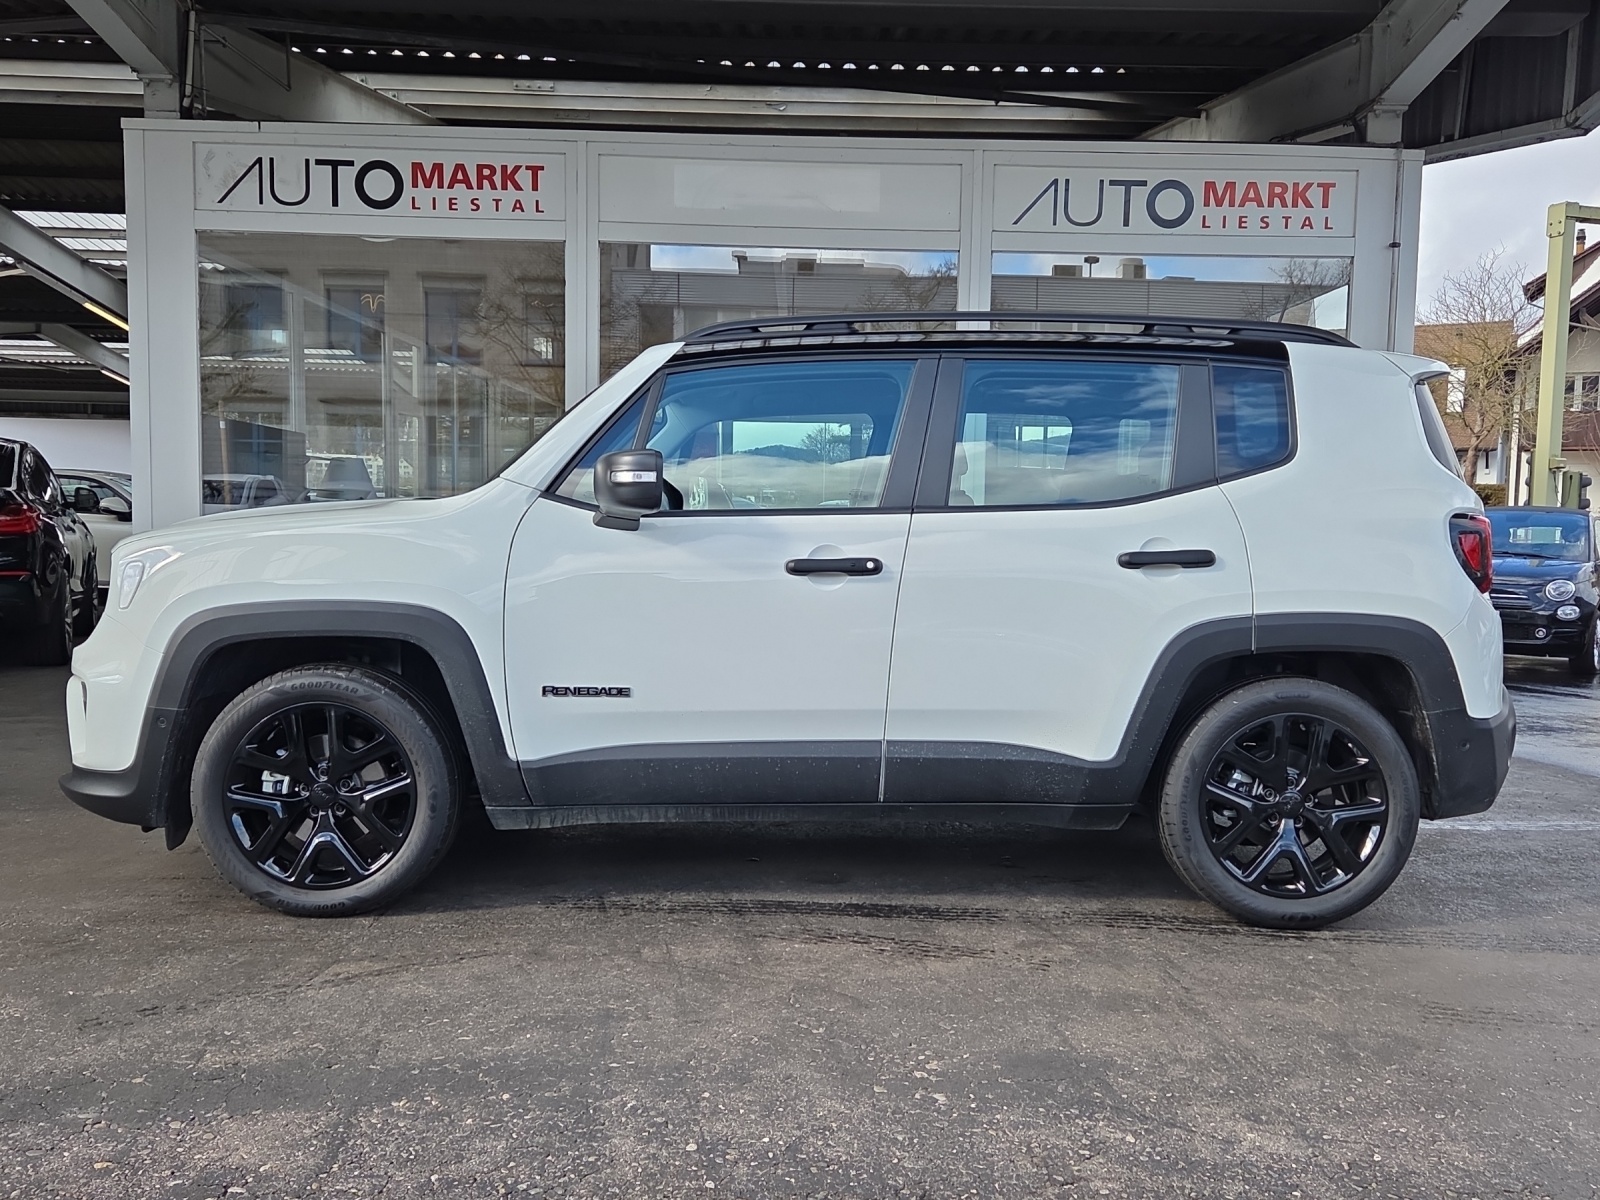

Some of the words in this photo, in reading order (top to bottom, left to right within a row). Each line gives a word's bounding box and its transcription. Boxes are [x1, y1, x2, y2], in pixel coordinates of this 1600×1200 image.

[217, 156, 404, 210] AUTO
[410, 161, 545, 192] MARKT
[410, 196, 545, 214] LIESTAL
[1011, 177, 1195, 229] AUTO
[1202, 180, 1337, 209] MARKT
[1201, 214, 1334, 231] LIESTAL
[291, 680, 359, 695] GOODYEAR
[541, 685, 631, 698] RENEGADE
